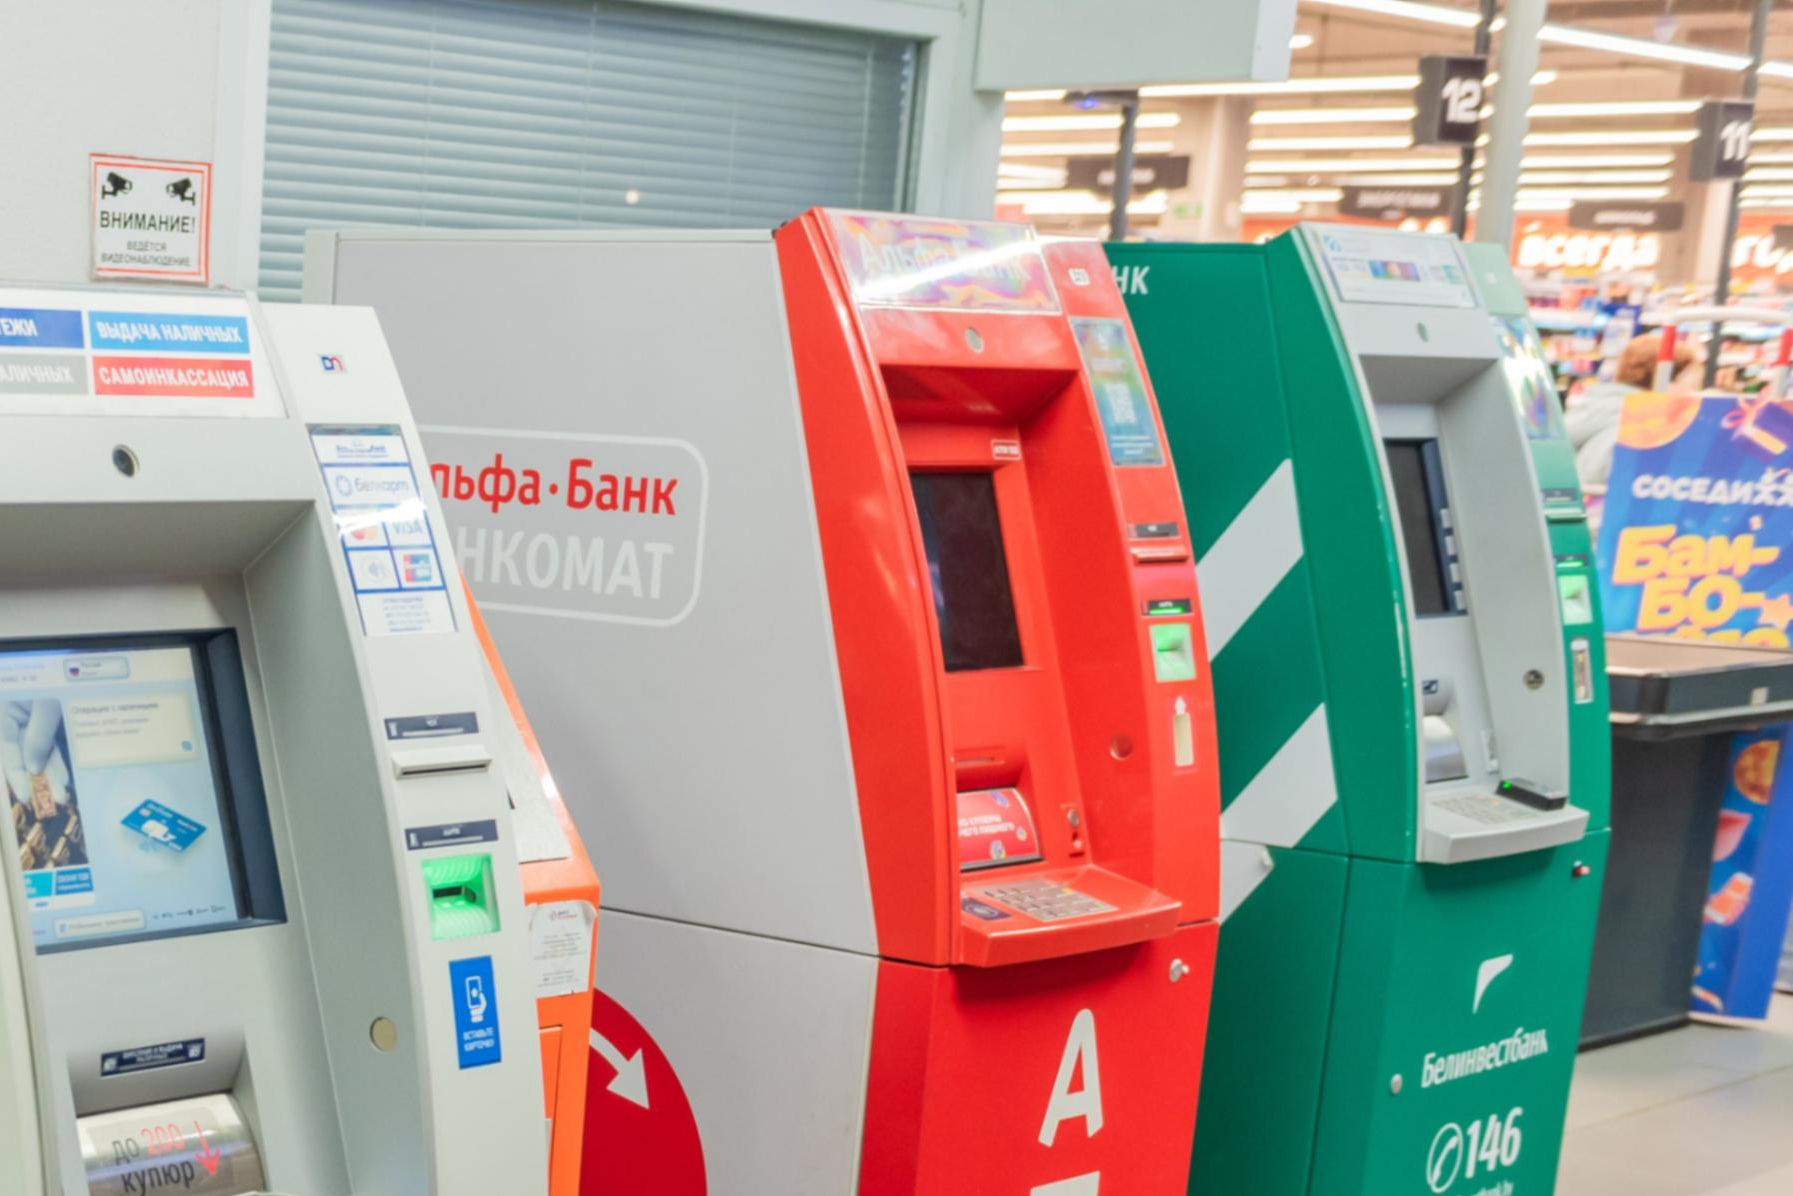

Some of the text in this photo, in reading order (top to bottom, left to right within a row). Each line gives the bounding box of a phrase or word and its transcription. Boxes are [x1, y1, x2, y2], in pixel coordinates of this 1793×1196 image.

[1442, 77, 1483, 124] 12
[1720, 120, 1751, 161] 11
[99, 210, 196, 234] ВНИМАНИЕ!
[96, 320, 243, 345] ВЫДАЧА НАЛИЧНЫХ
[98, 366, 249, 390] САМОИНКАССАЦИЯ
[1420, 1026, 1549, 1089] Белинвестбанк
[111, 1123, 186, 1165] до 200
[1465, 1106, 1524, 1179] 146
